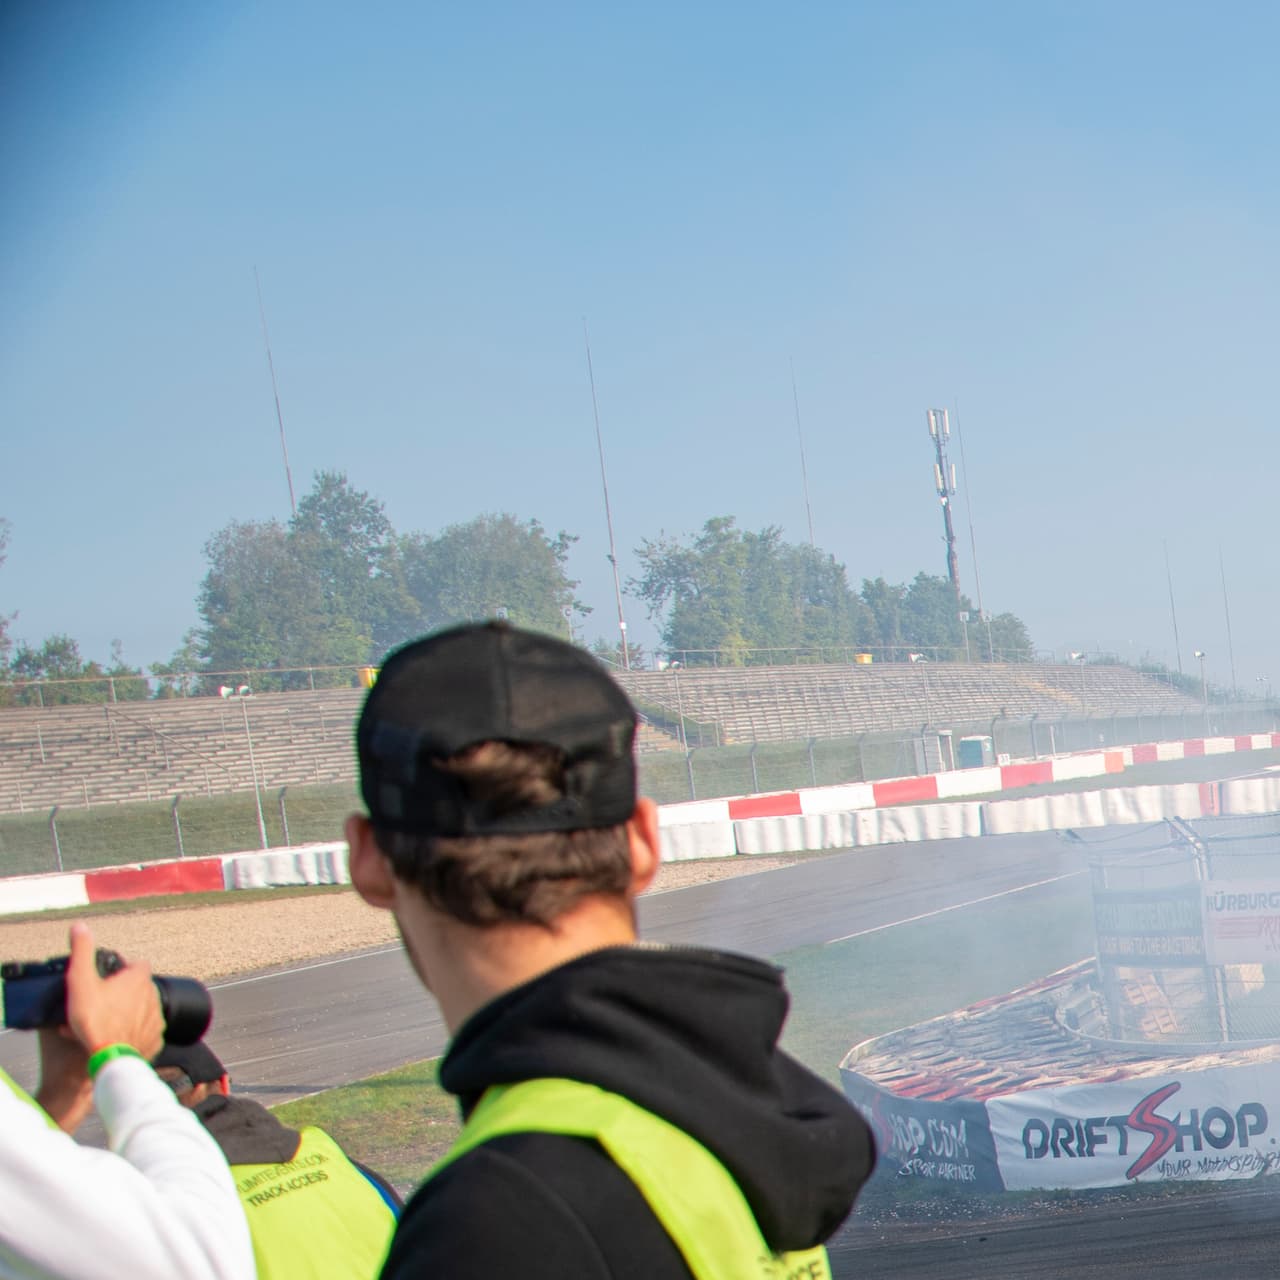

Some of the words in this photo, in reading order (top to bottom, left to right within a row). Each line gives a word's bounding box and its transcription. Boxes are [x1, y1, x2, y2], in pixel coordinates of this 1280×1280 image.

[1156, 1159, 1192, 1179] YOUR
[247, 1184, 290, 1208] TRACK
[287, 1169, 330, 1191] ACCESS
